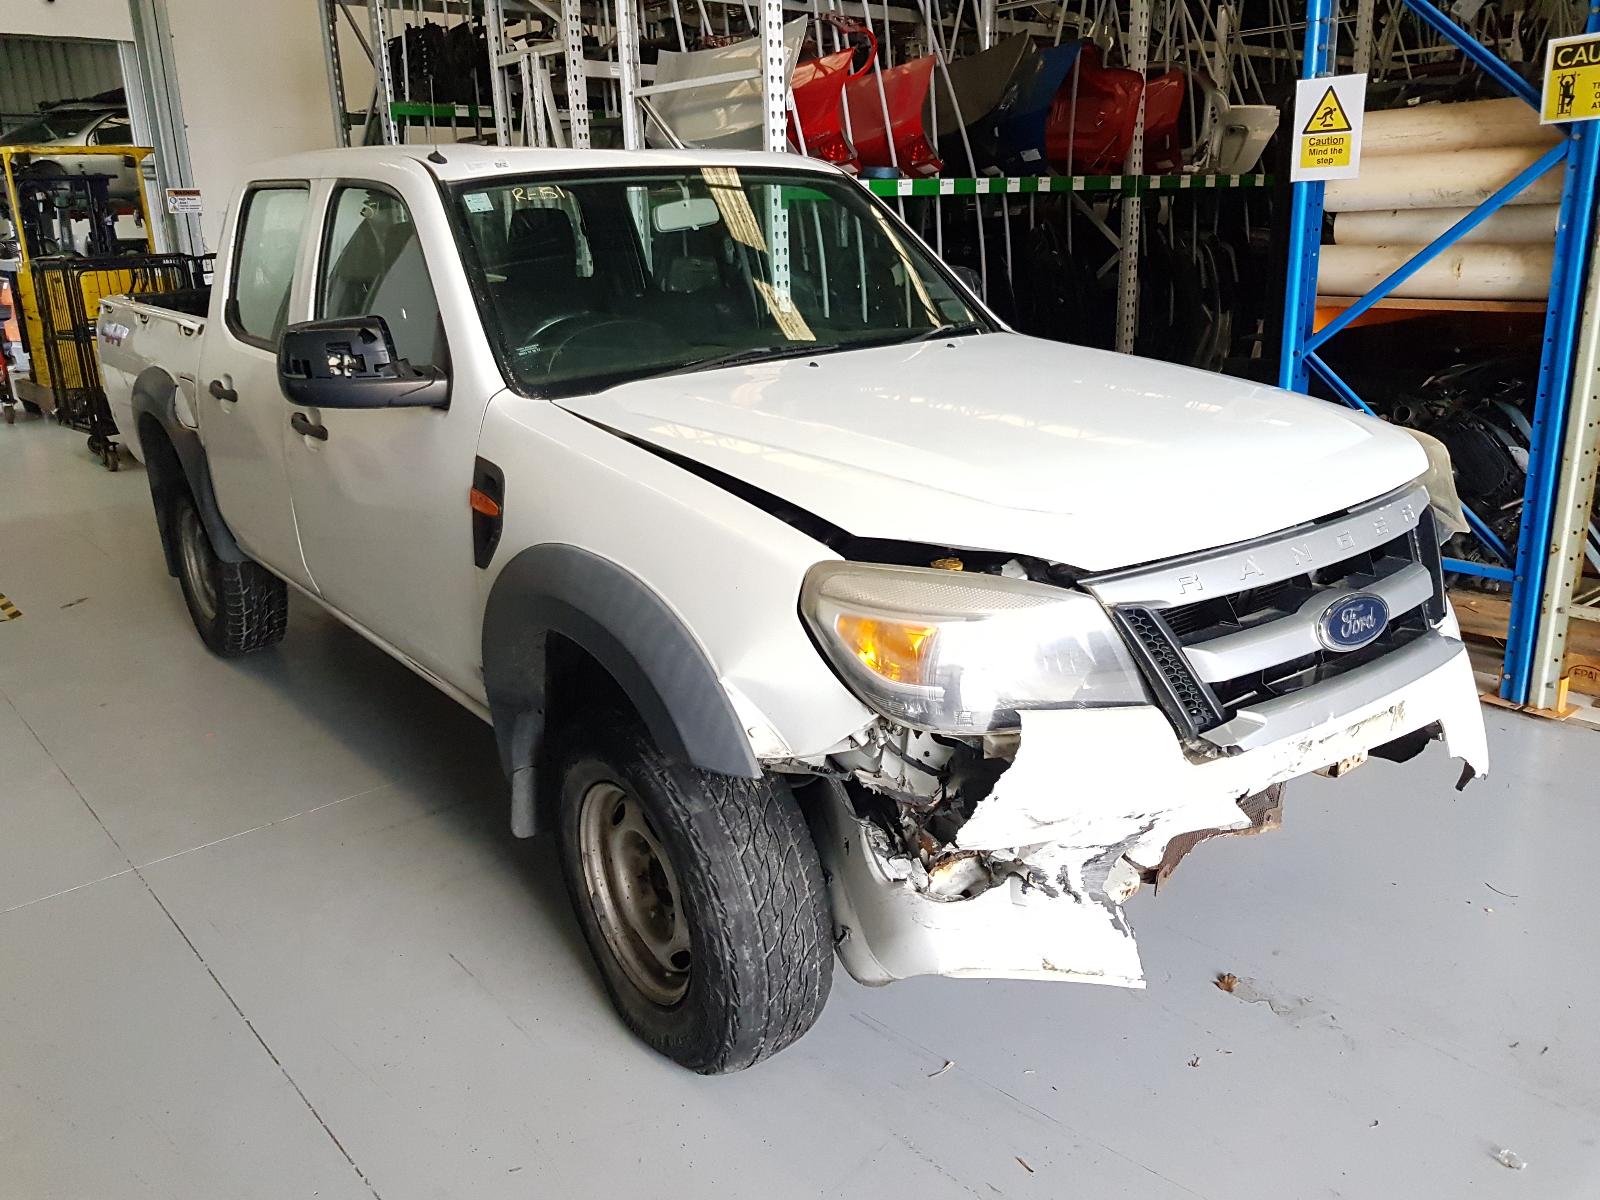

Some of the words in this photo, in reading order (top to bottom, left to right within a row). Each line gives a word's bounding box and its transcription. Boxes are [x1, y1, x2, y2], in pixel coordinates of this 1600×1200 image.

[1309, 136, 1344, 146] Caution
[1309, 148, 1328, 156] Mind
[1330, 147, 1343, 155] the
[1316, 157, 1334, 165] step
[1179, 503, 1416, 595] RANGER
[1341, 604, 1377, 638] Ford
